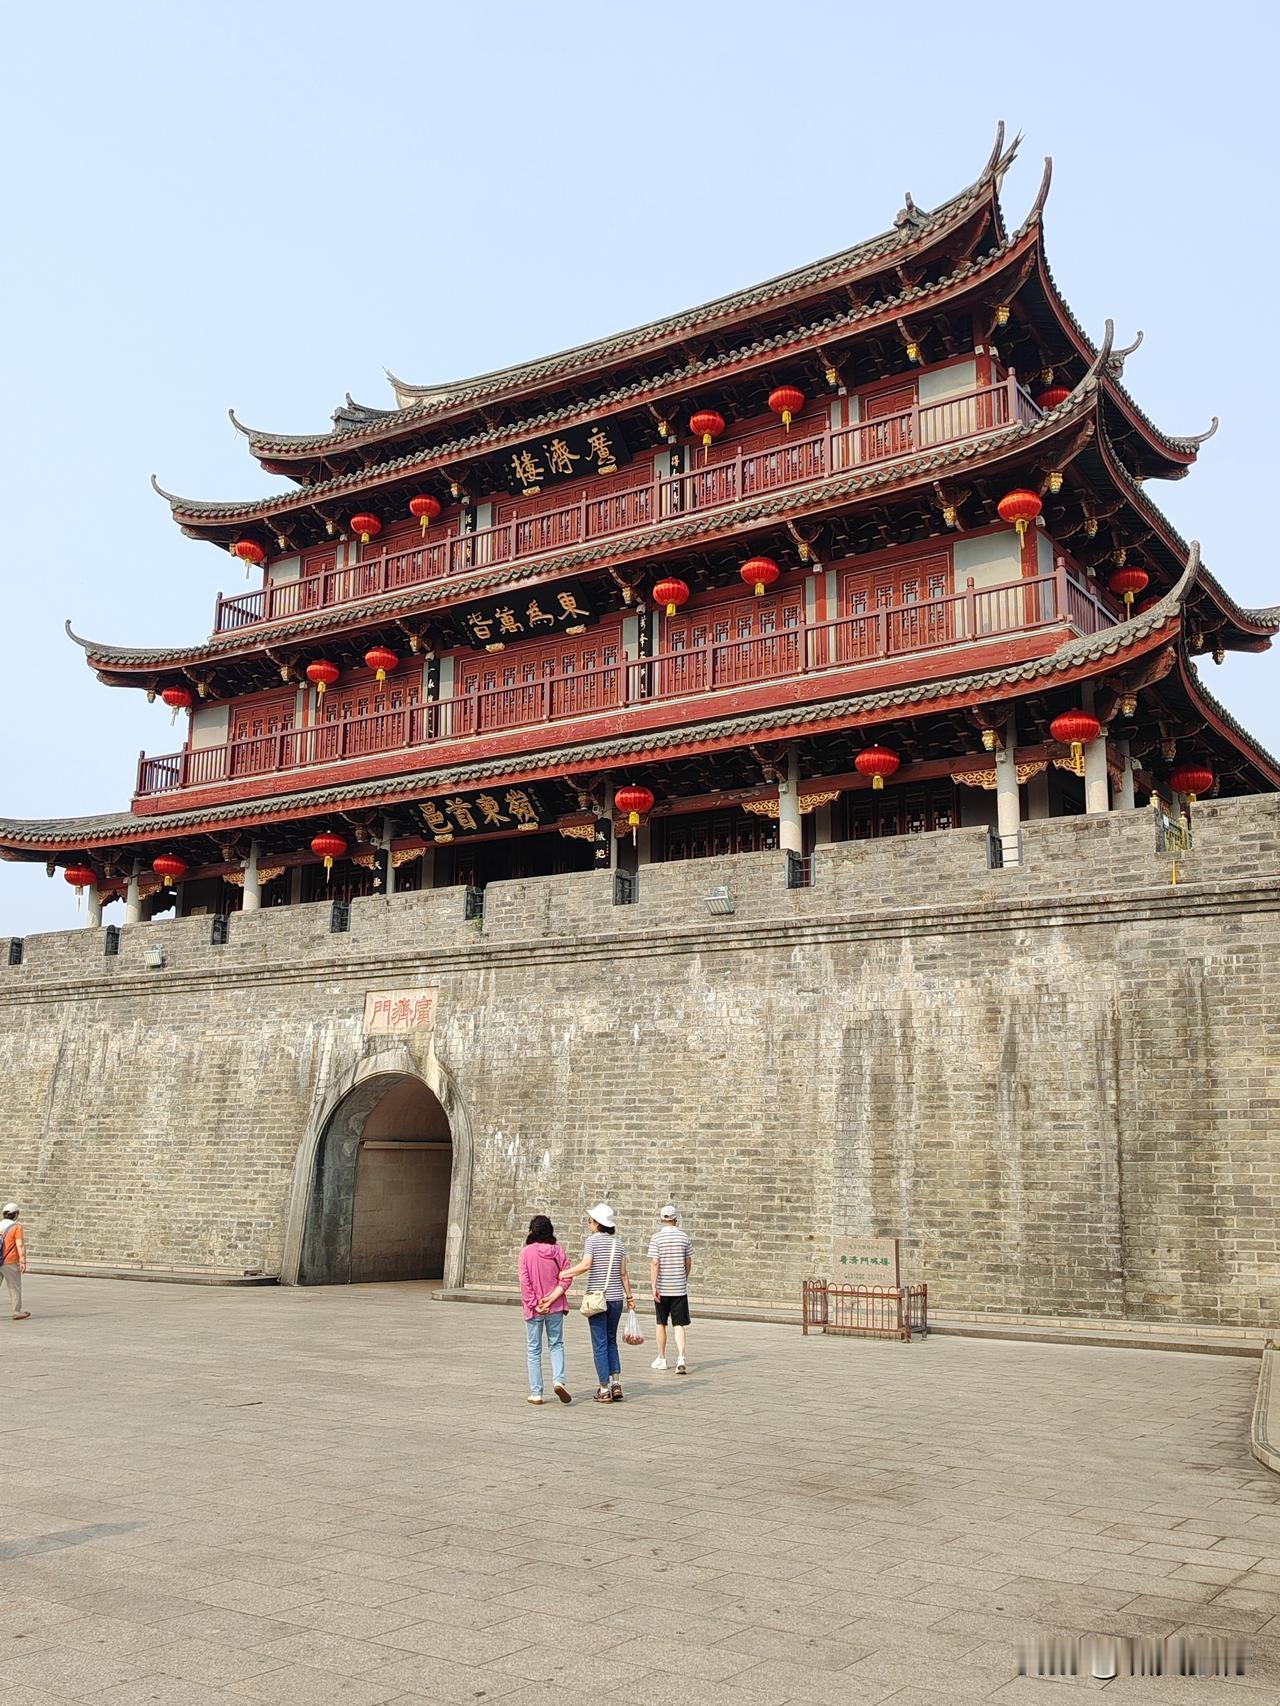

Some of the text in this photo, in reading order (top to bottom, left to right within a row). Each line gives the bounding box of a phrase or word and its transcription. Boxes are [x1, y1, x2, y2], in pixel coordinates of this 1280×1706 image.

[511, 426, 617, 486] 廣濟樓
[418, 788, 540, 834] 嶺東首邑
[369, 994, 433, 1028] 廣濟門
